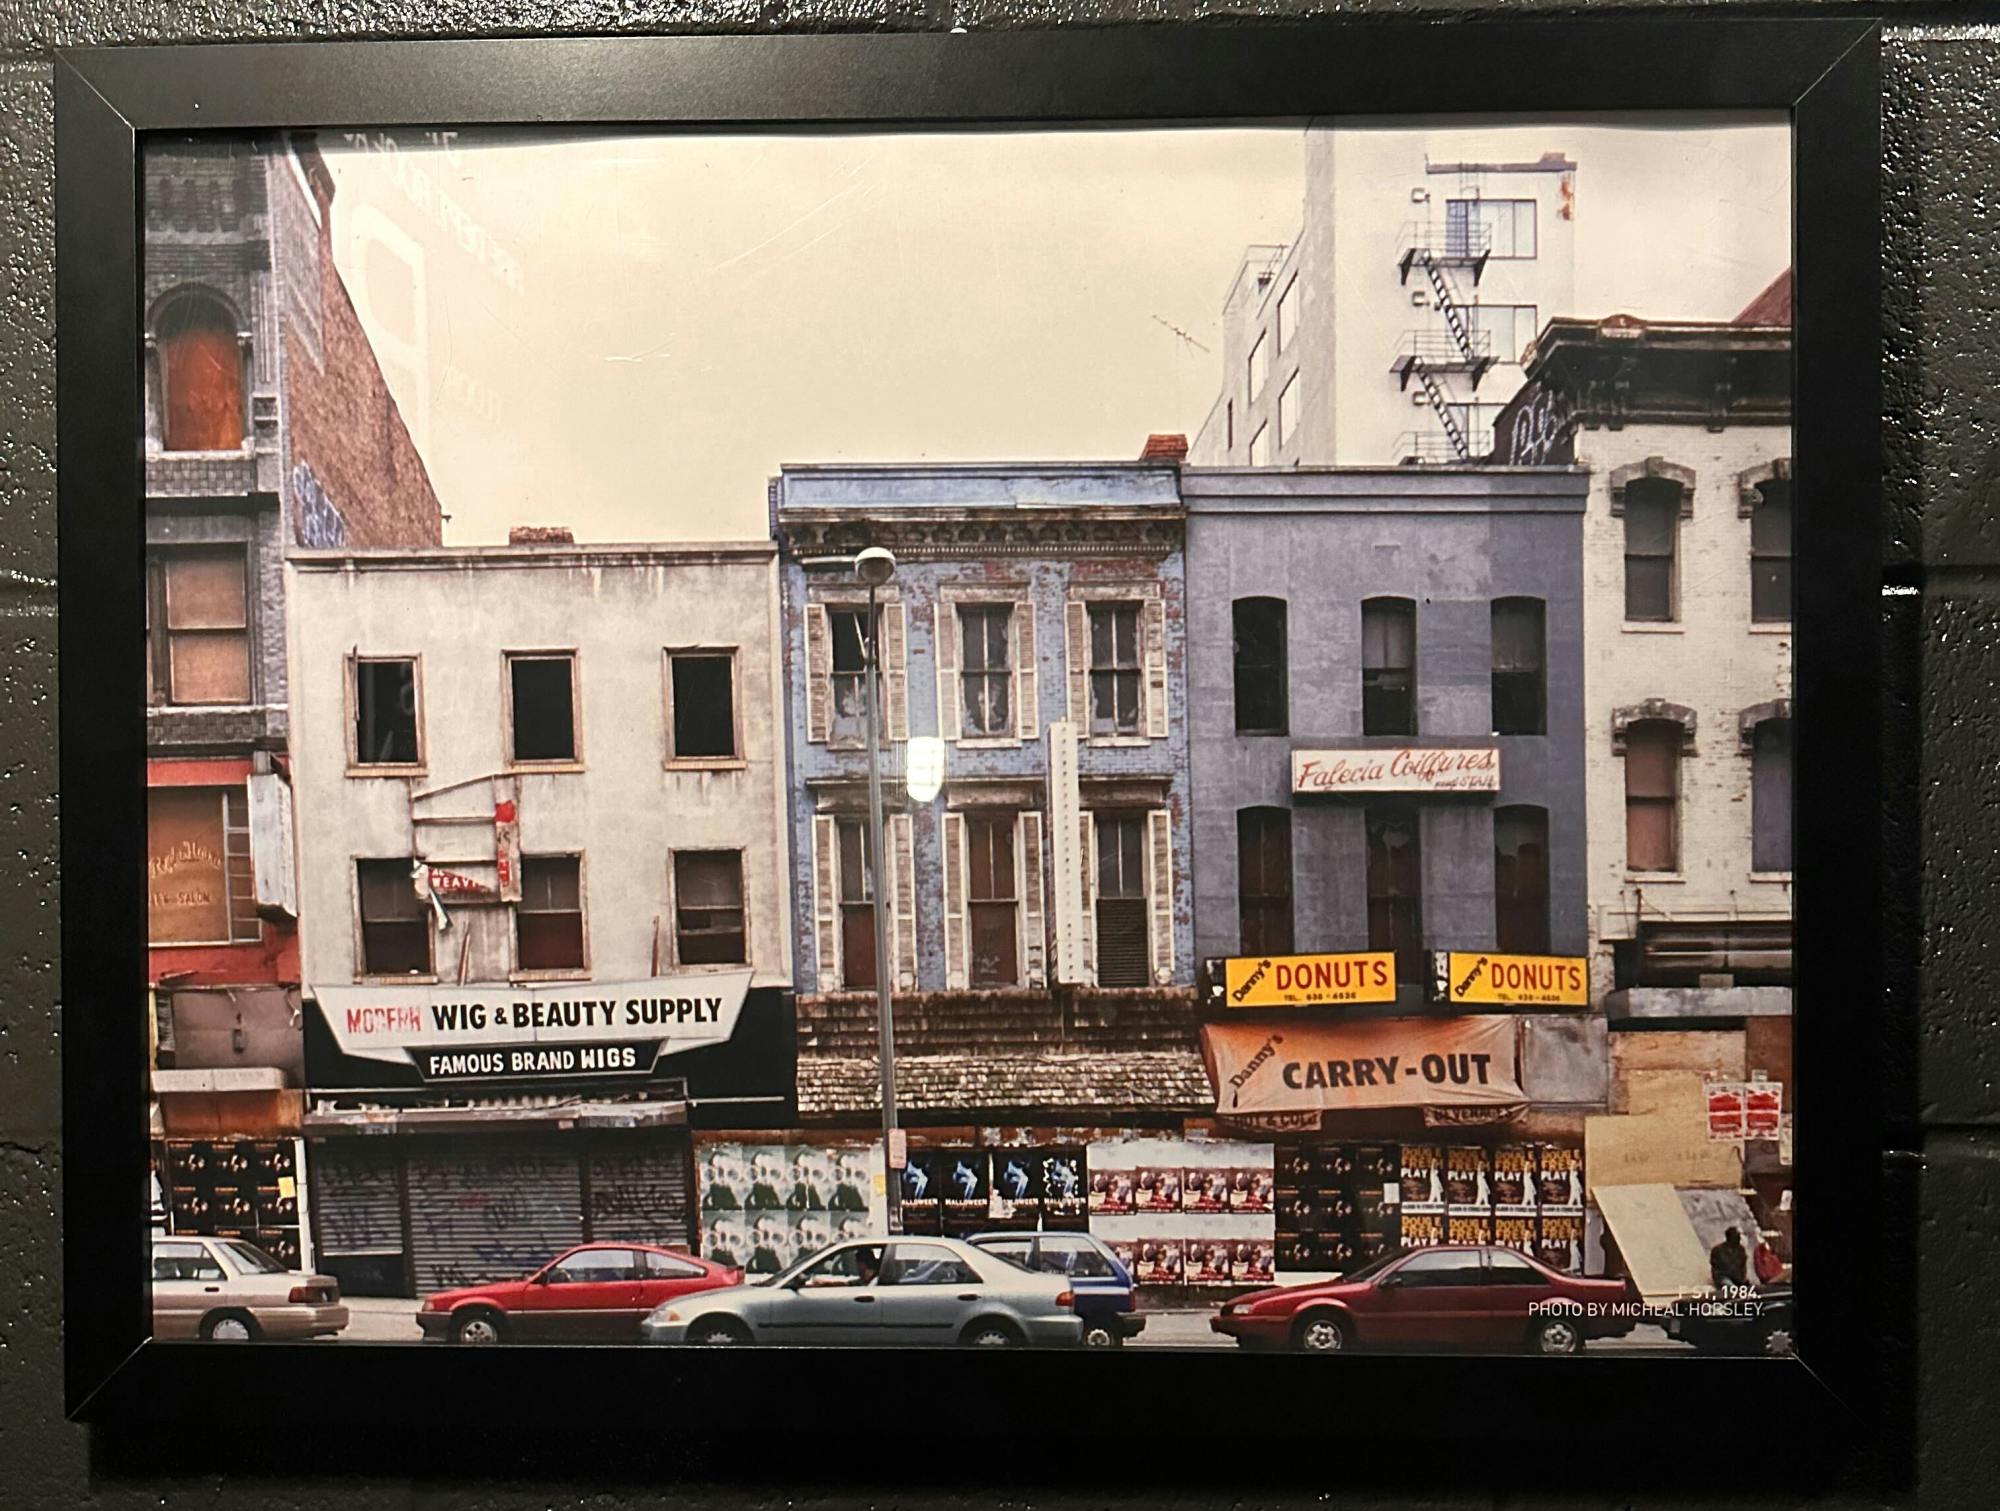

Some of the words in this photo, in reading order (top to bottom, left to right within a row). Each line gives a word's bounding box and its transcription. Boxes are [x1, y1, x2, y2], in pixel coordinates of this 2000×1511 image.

[432, 877, 477, 887] WEAVI
[1232, 960, 1272, 1002] Danny's
[1276, 960, 1388, 990] DONUTS
[1455, 957, 1488, 997] Danny's
[1491, 963, 1581, 991] DONUTS
[432, 1004, 487, 1031] WIG
[494, 1007, 508, 1025] &
[513, 1001, 616, 1028] BEAUTY
[626, 998, 722, 1024] SUPPLY
[430, 1054, 504, 1075] FAMOUS
[511, 1050, 574, 1071] BRAND
[581, 1047, 636, 1069] WIGS
[1228, 1033, 1284, 1090] Danny's
[1283, 1053, 1491, 1090] CARRY-OUT
[1401, 1168, 1428, 1178] PLAY
[1448, 1171, 1474, 1180] PLAY
[1495, 1171, 1521, 1181] PLAY
[1541, 1171, 1567, 1180] PLAY
[901, 1198, 938, 1206] ALLOWEEN
[945, 1198, 988, 1206] HALLOWEEN
[1542, 1239, 1567, 1248] PLAY
